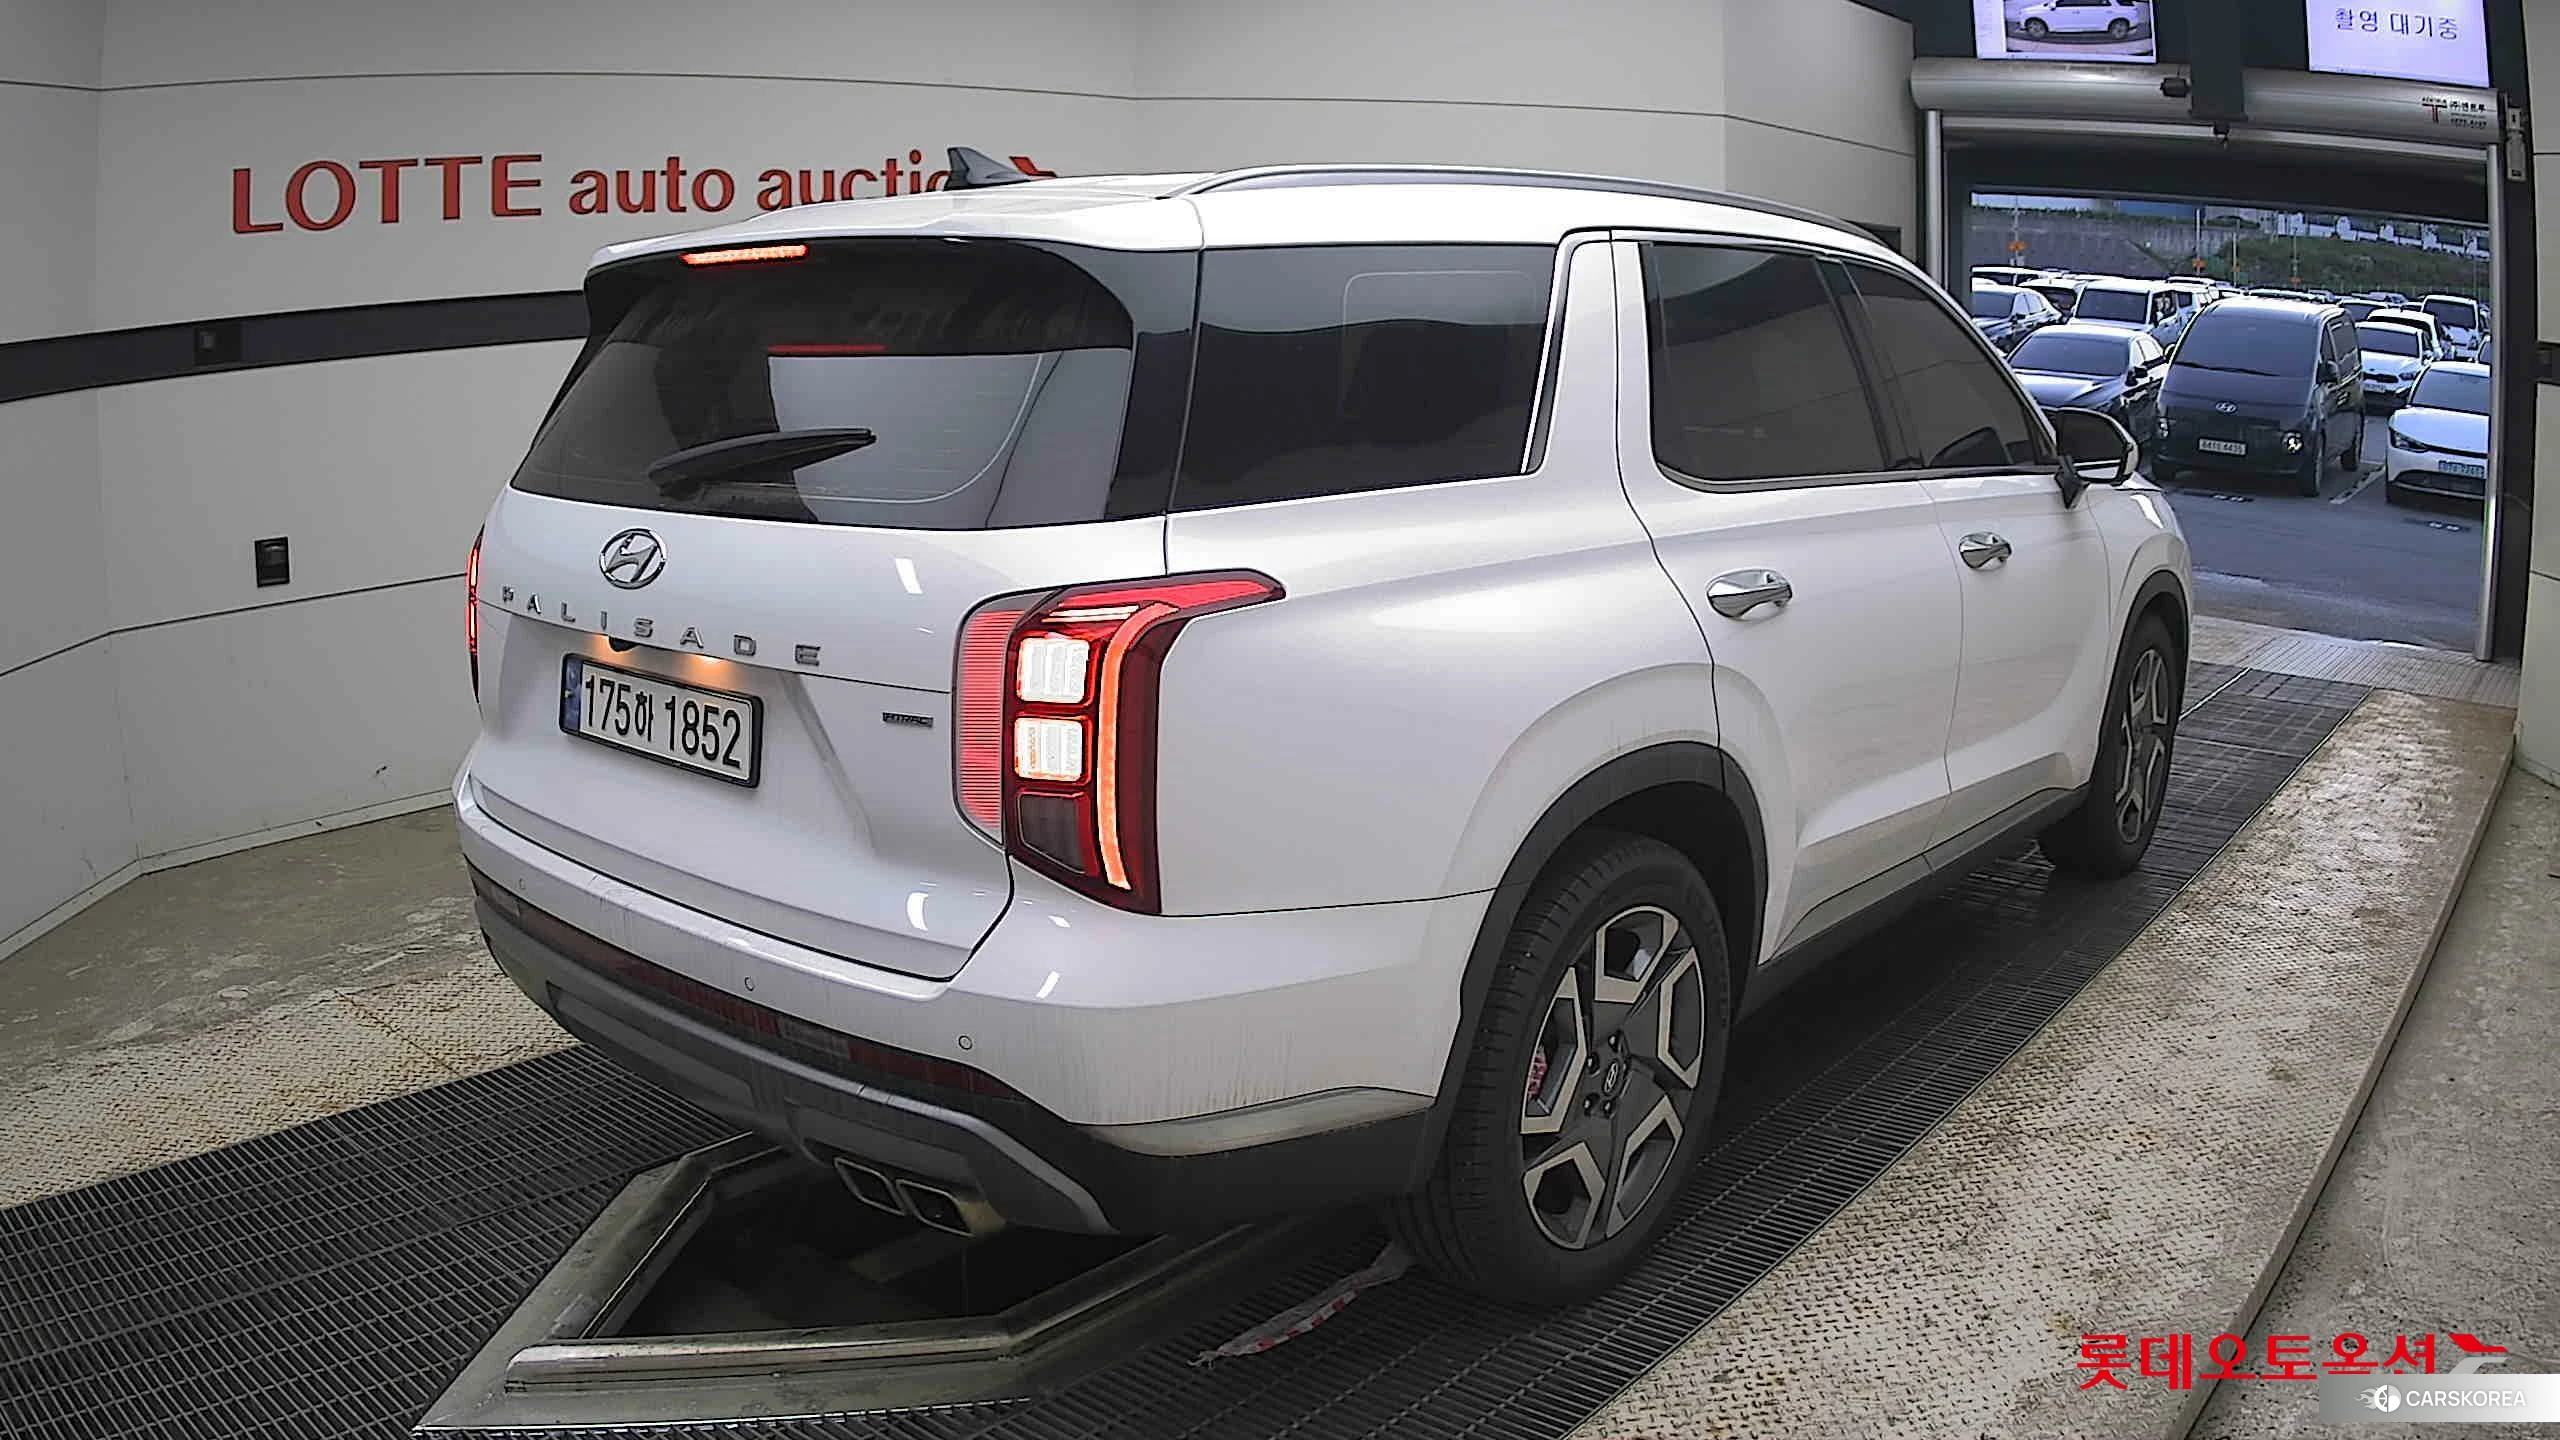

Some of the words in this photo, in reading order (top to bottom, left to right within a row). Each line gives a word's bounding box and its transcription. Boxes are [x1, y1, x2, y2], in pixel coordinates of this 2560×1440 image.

[2336, 8, 2378, 32] 촬영
[2390, 13, 2457, 40] 대기중
[232, 154, 542, 234] LOTTE
[568, 157, 735, 215] auto
[757, 149, 949, 212] aucti
[502, 585, 821, 667] PALISADE
[585, 674, 654, 743] 175하
[664, 695, 742, 769] 1852
